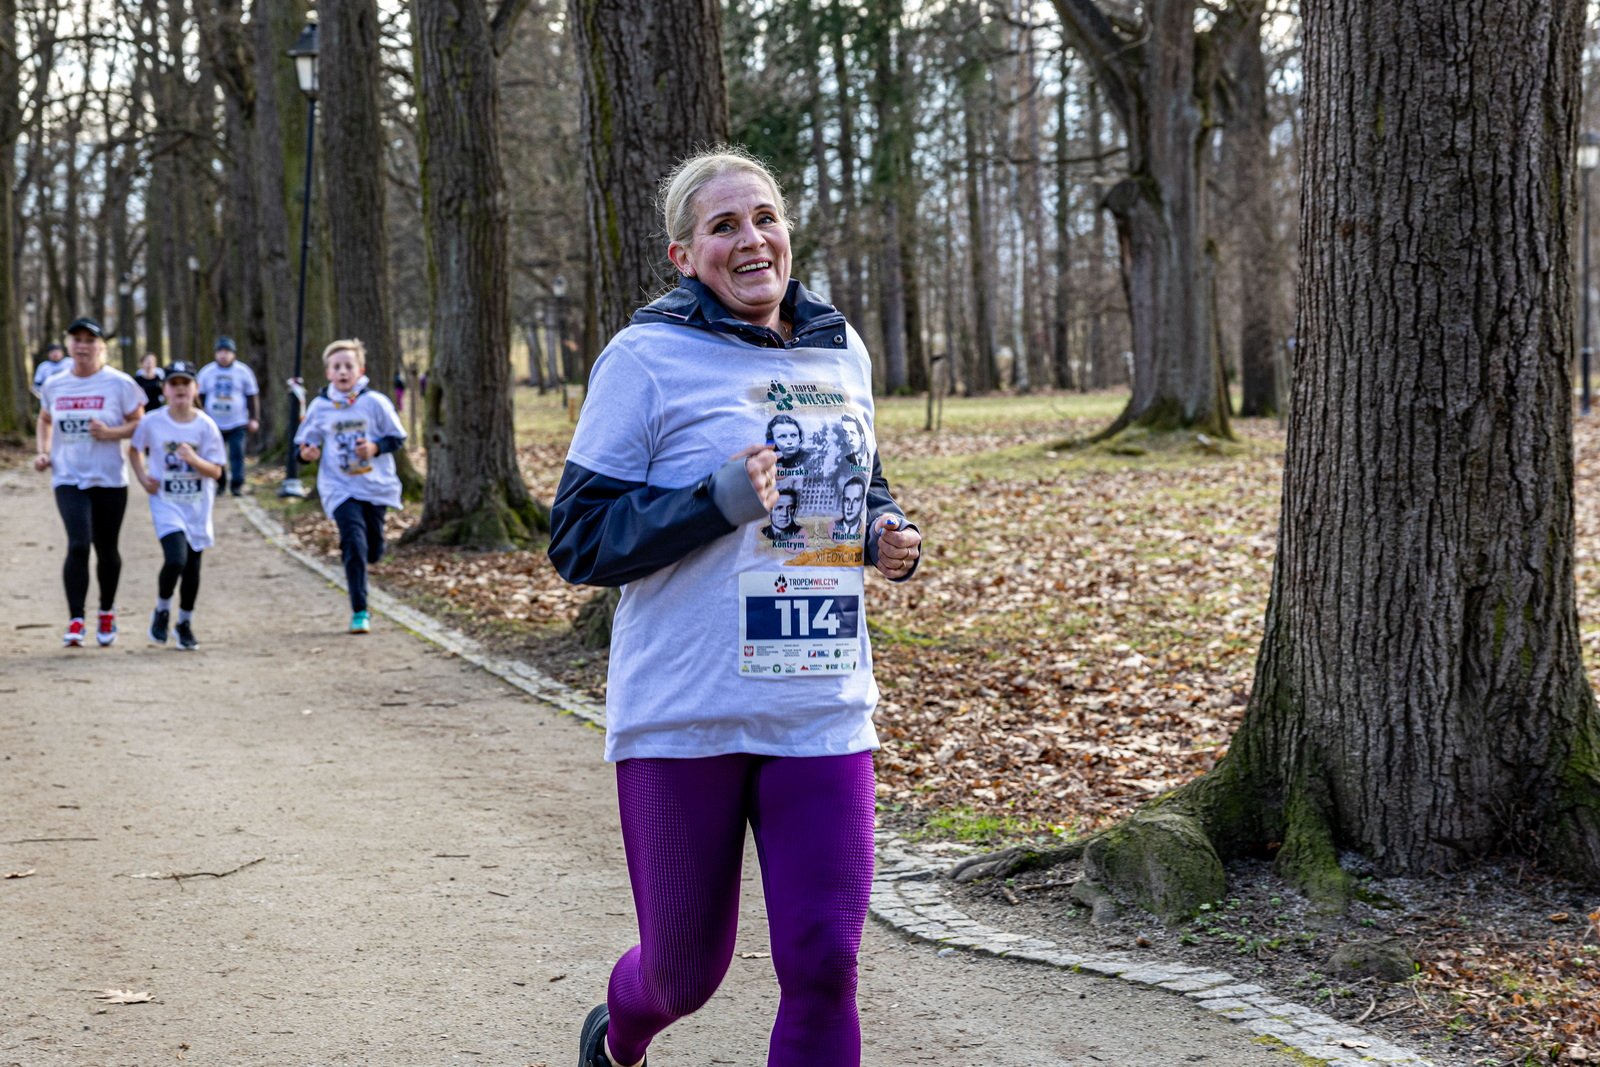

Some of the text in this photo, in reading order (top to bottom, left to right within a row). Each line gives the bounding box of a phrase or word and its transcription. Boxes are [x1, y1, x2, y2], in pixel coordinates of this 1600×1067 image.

[790, 384, 818, 392] TROPEM
[795, 393, 845, 405] WILCZYM
[777, 468, 808, 476] tolarska
[170, 480, 198, 493] 035
[772, 540, 805, 550] Kontrym
[775, 599, 840, 636] 114
